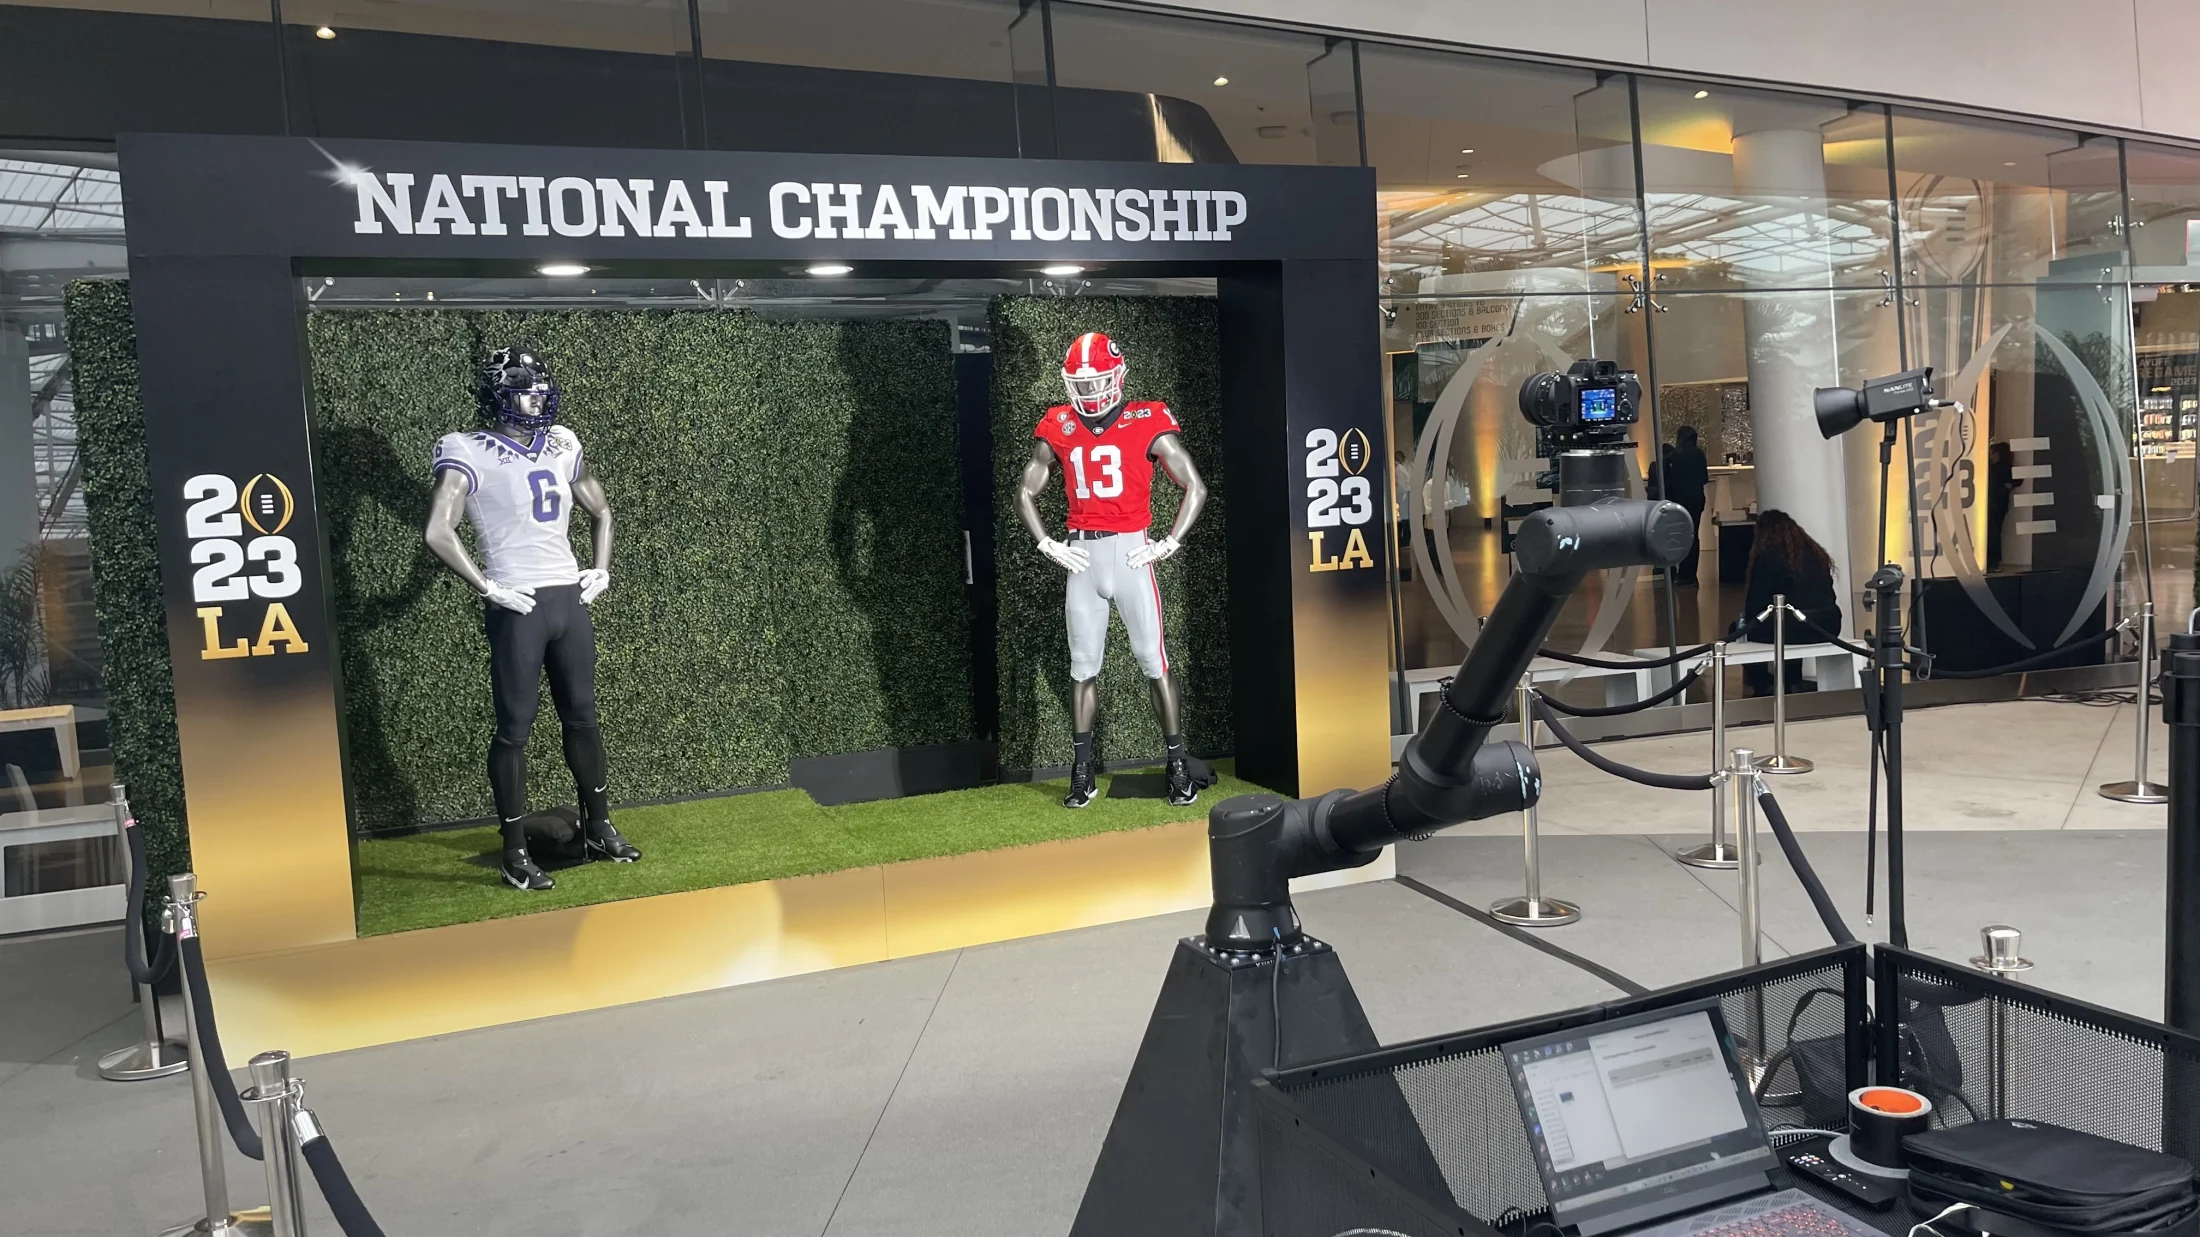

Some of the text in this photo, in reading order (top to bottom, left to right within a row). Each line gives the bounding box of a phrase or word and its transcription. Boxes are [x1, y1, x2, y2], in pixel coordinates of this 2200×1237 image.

[351, 172, 1247, 242] NATIONAL CHAMPIONSHIP
[1415, 311, 1429, 320] 300
[1431, 307, 1466, 320] SECTIONS
[1476, 304, 1510, 315] BALCONY
[1429, 318, 1460, 329] SECTION
[1436, 326, 1471, 338] SECTIONS
[2139, 357, 2171, 367] AYOFF
[2138, 365, 2197, 378] REGAME
[1883, 382, 1913, 393] NANLITE
[2170, 376, 2197, 386] 2023
[1069, 444, 1124, 500] 13
[1307, 476, 1373, 528] 23
[1308, 528, 1374, 572] LA
[190, 535, 303, 602] 23
[196, 602, 309, 660] LA
